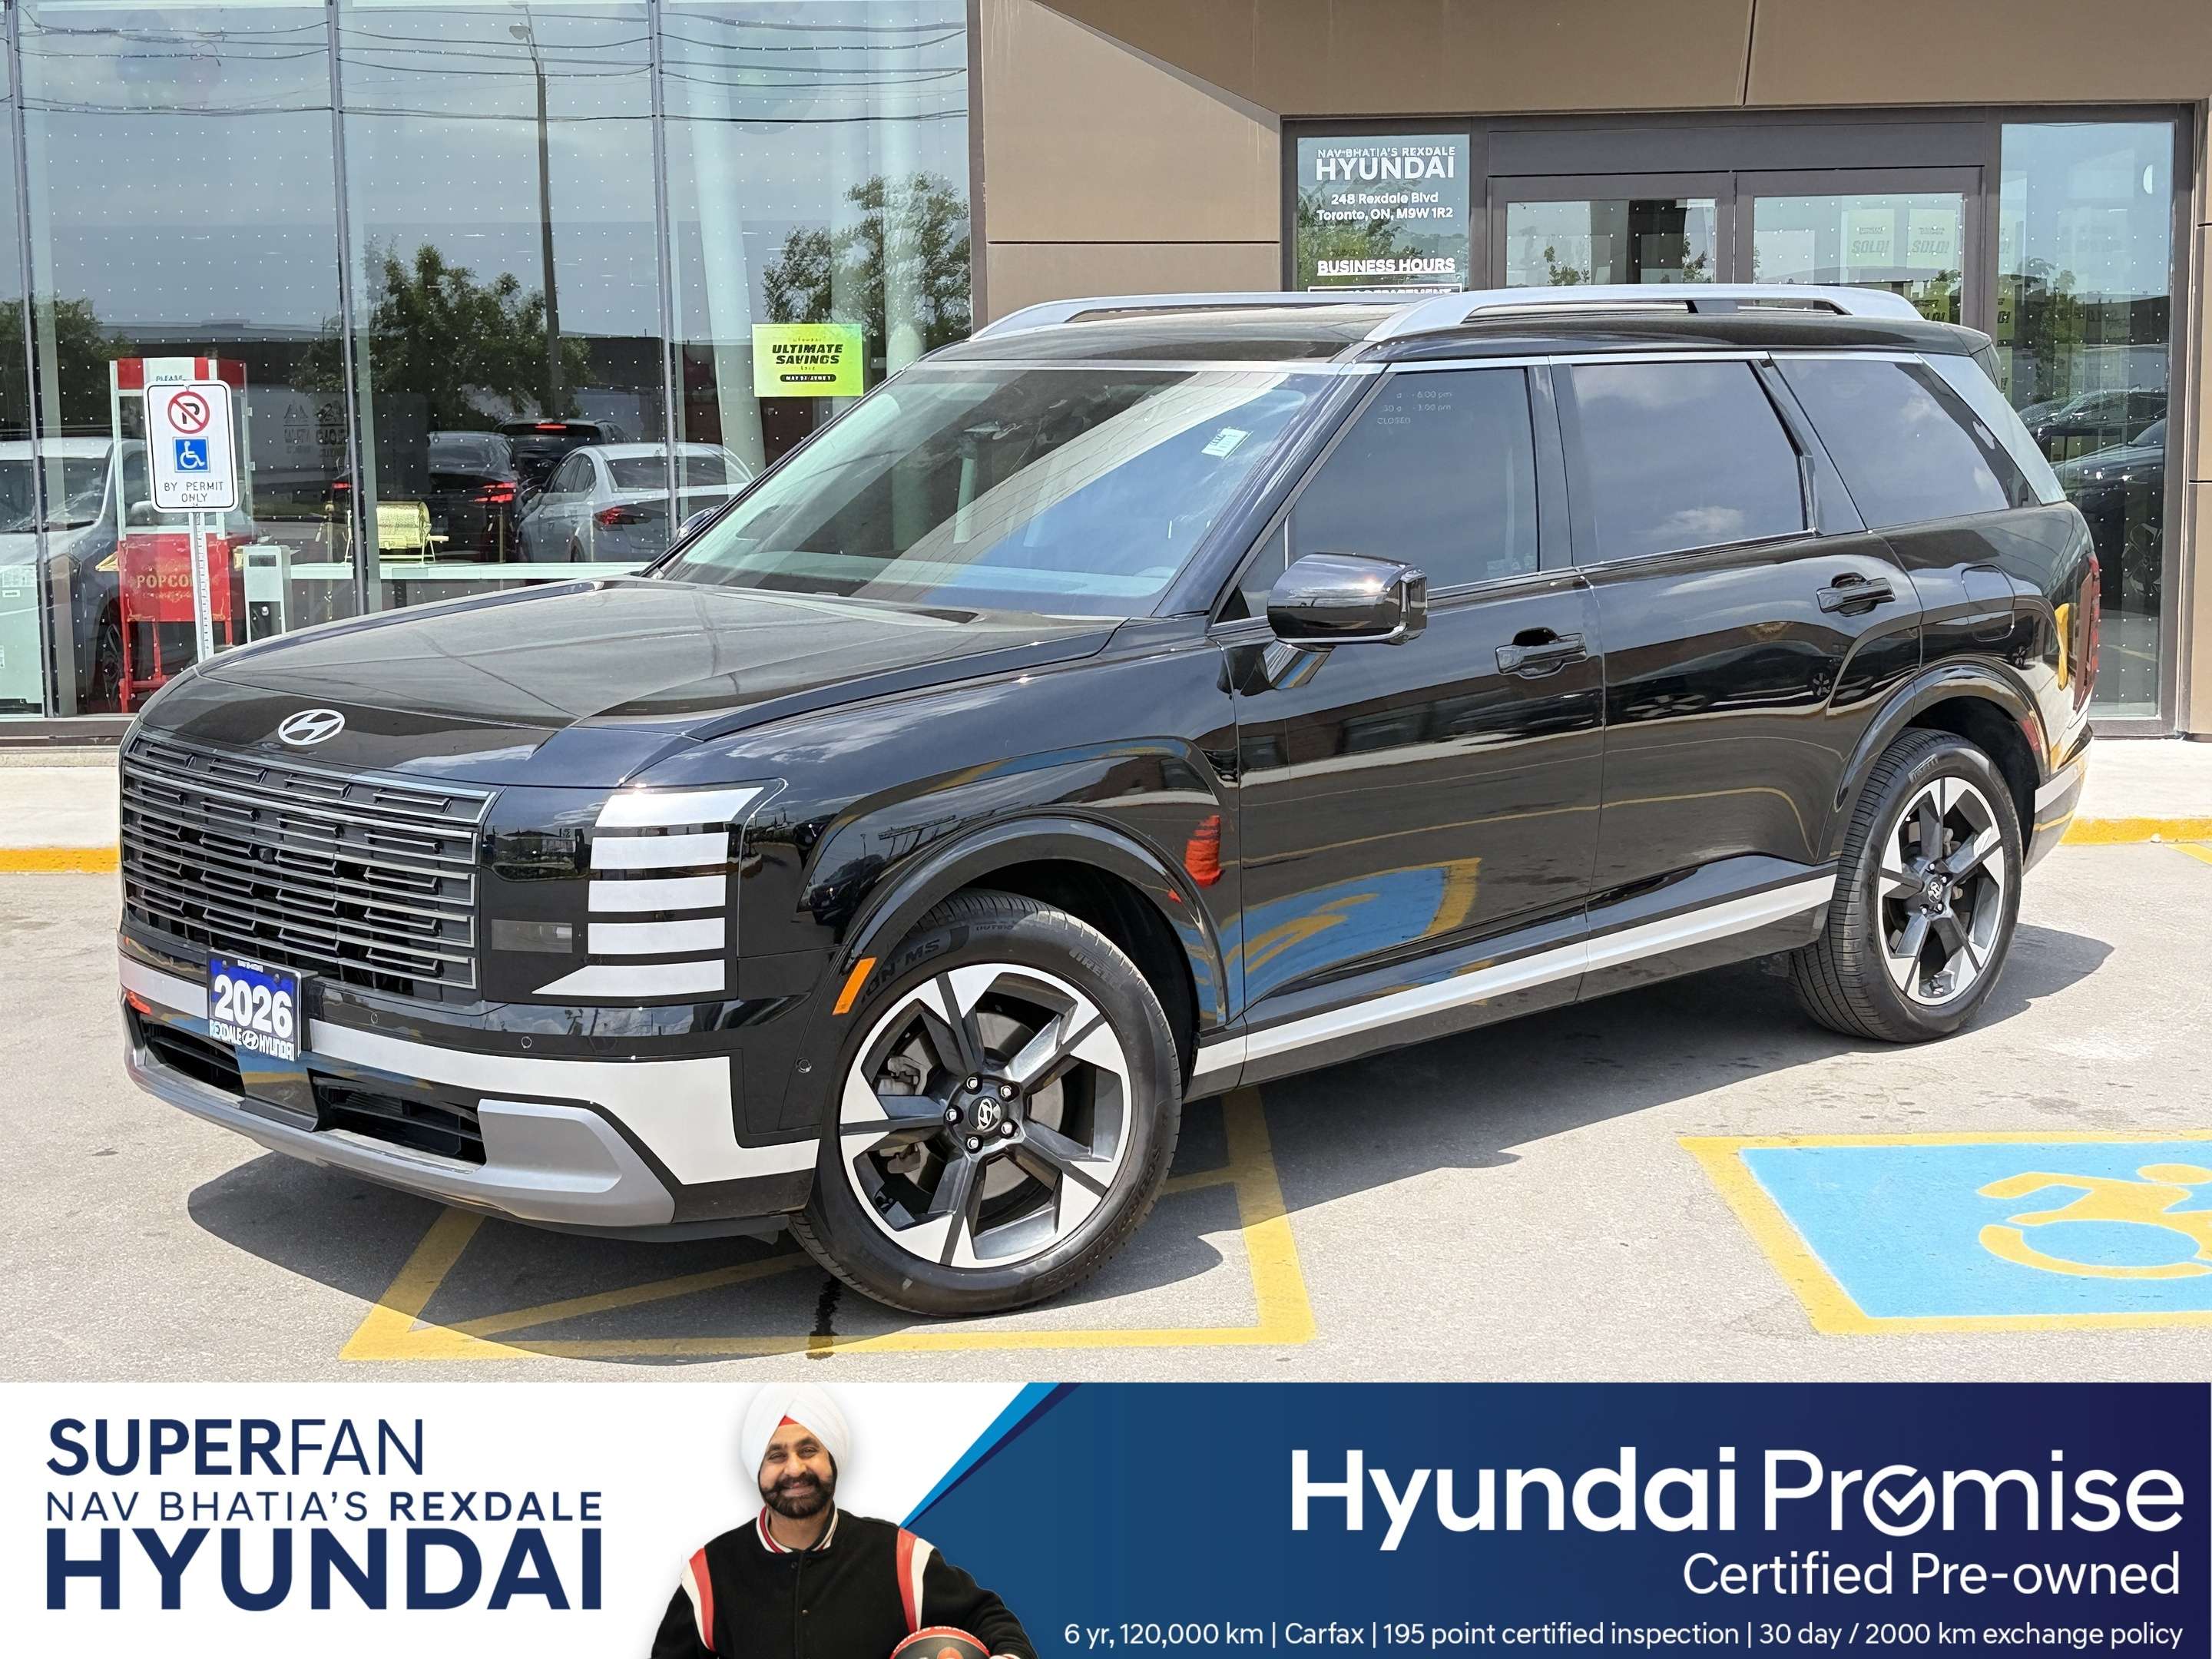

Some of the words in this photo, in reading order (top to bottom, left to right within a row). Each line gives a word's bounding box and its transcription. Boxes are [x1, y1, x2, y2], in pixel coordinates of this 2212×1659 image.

[1318, 148, 1341, 158] NAV
[1346, 147, 1398, 157] BHATIA'S
[1402, 146, 1456, 157] REXDALE
[1316, 156, 1455, 180] HYUNDAI
[1331, 193, 1356, 205] 248
[1359, 192, 1409, 204] Rexdale
[1411, 191, 1439, 204] Blvd
[1316, 209, 1369, 222] Toronto,
[1370, 208, 1394, 221] ON,
[1396, 207, 1430, 219] M9W
[1431, 207, 1453, 219] 1R2
[1851, 240, 1891, 253] SOLD!
[1912, 240, 1950, 253] SOLD!
[1317, 259, 1396, 274] BUSINESS
[1399, 257, 1456, 273] HOURS
[772, 344, 843, 353] ULTIMATE
[776, 355, 840, 364] SAVINGS
[164, 482, 178, 492] BY
[186, 481, 224, 492] PERMIT
[181, 492, 207, 502] ONLY
[137, 574, 192, 589] POPCO
[214, 973, 293, 1039] 2026
[259, 1034, 296, 1062] HYUNDAI
